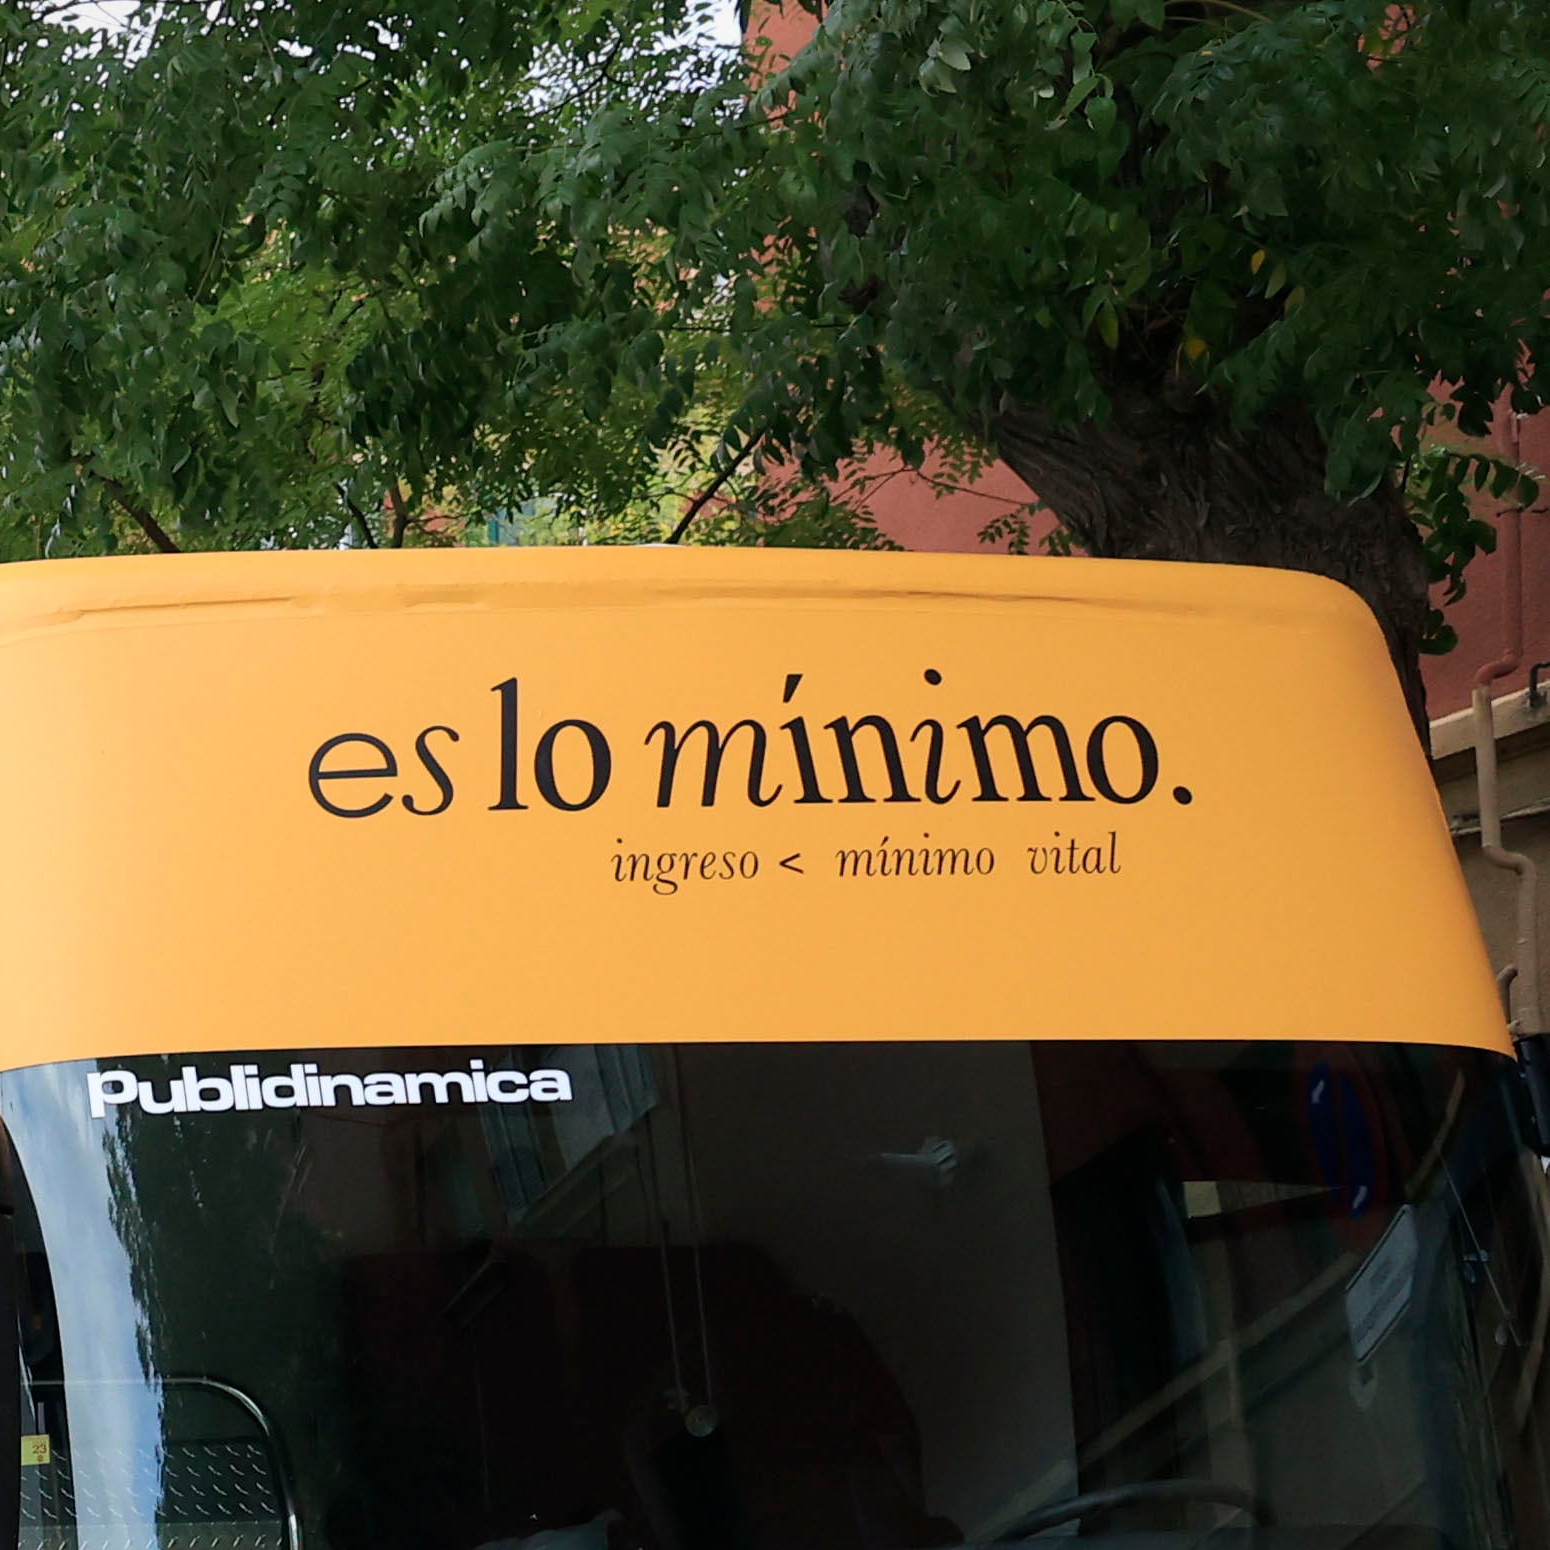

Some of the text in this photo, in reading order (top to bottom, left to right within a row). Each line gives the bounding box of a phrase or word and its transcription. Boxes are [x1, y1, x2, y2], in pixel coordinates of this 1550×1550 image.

[308, 669, 1194, 819] es lo mínimo.
[611, 838, 760, 896] ingreso
[835, 834, 996, 879] mínimo
[1026, 831, 1123, 876] vital
[86, 1059, 573, 1119] Publidinamica
